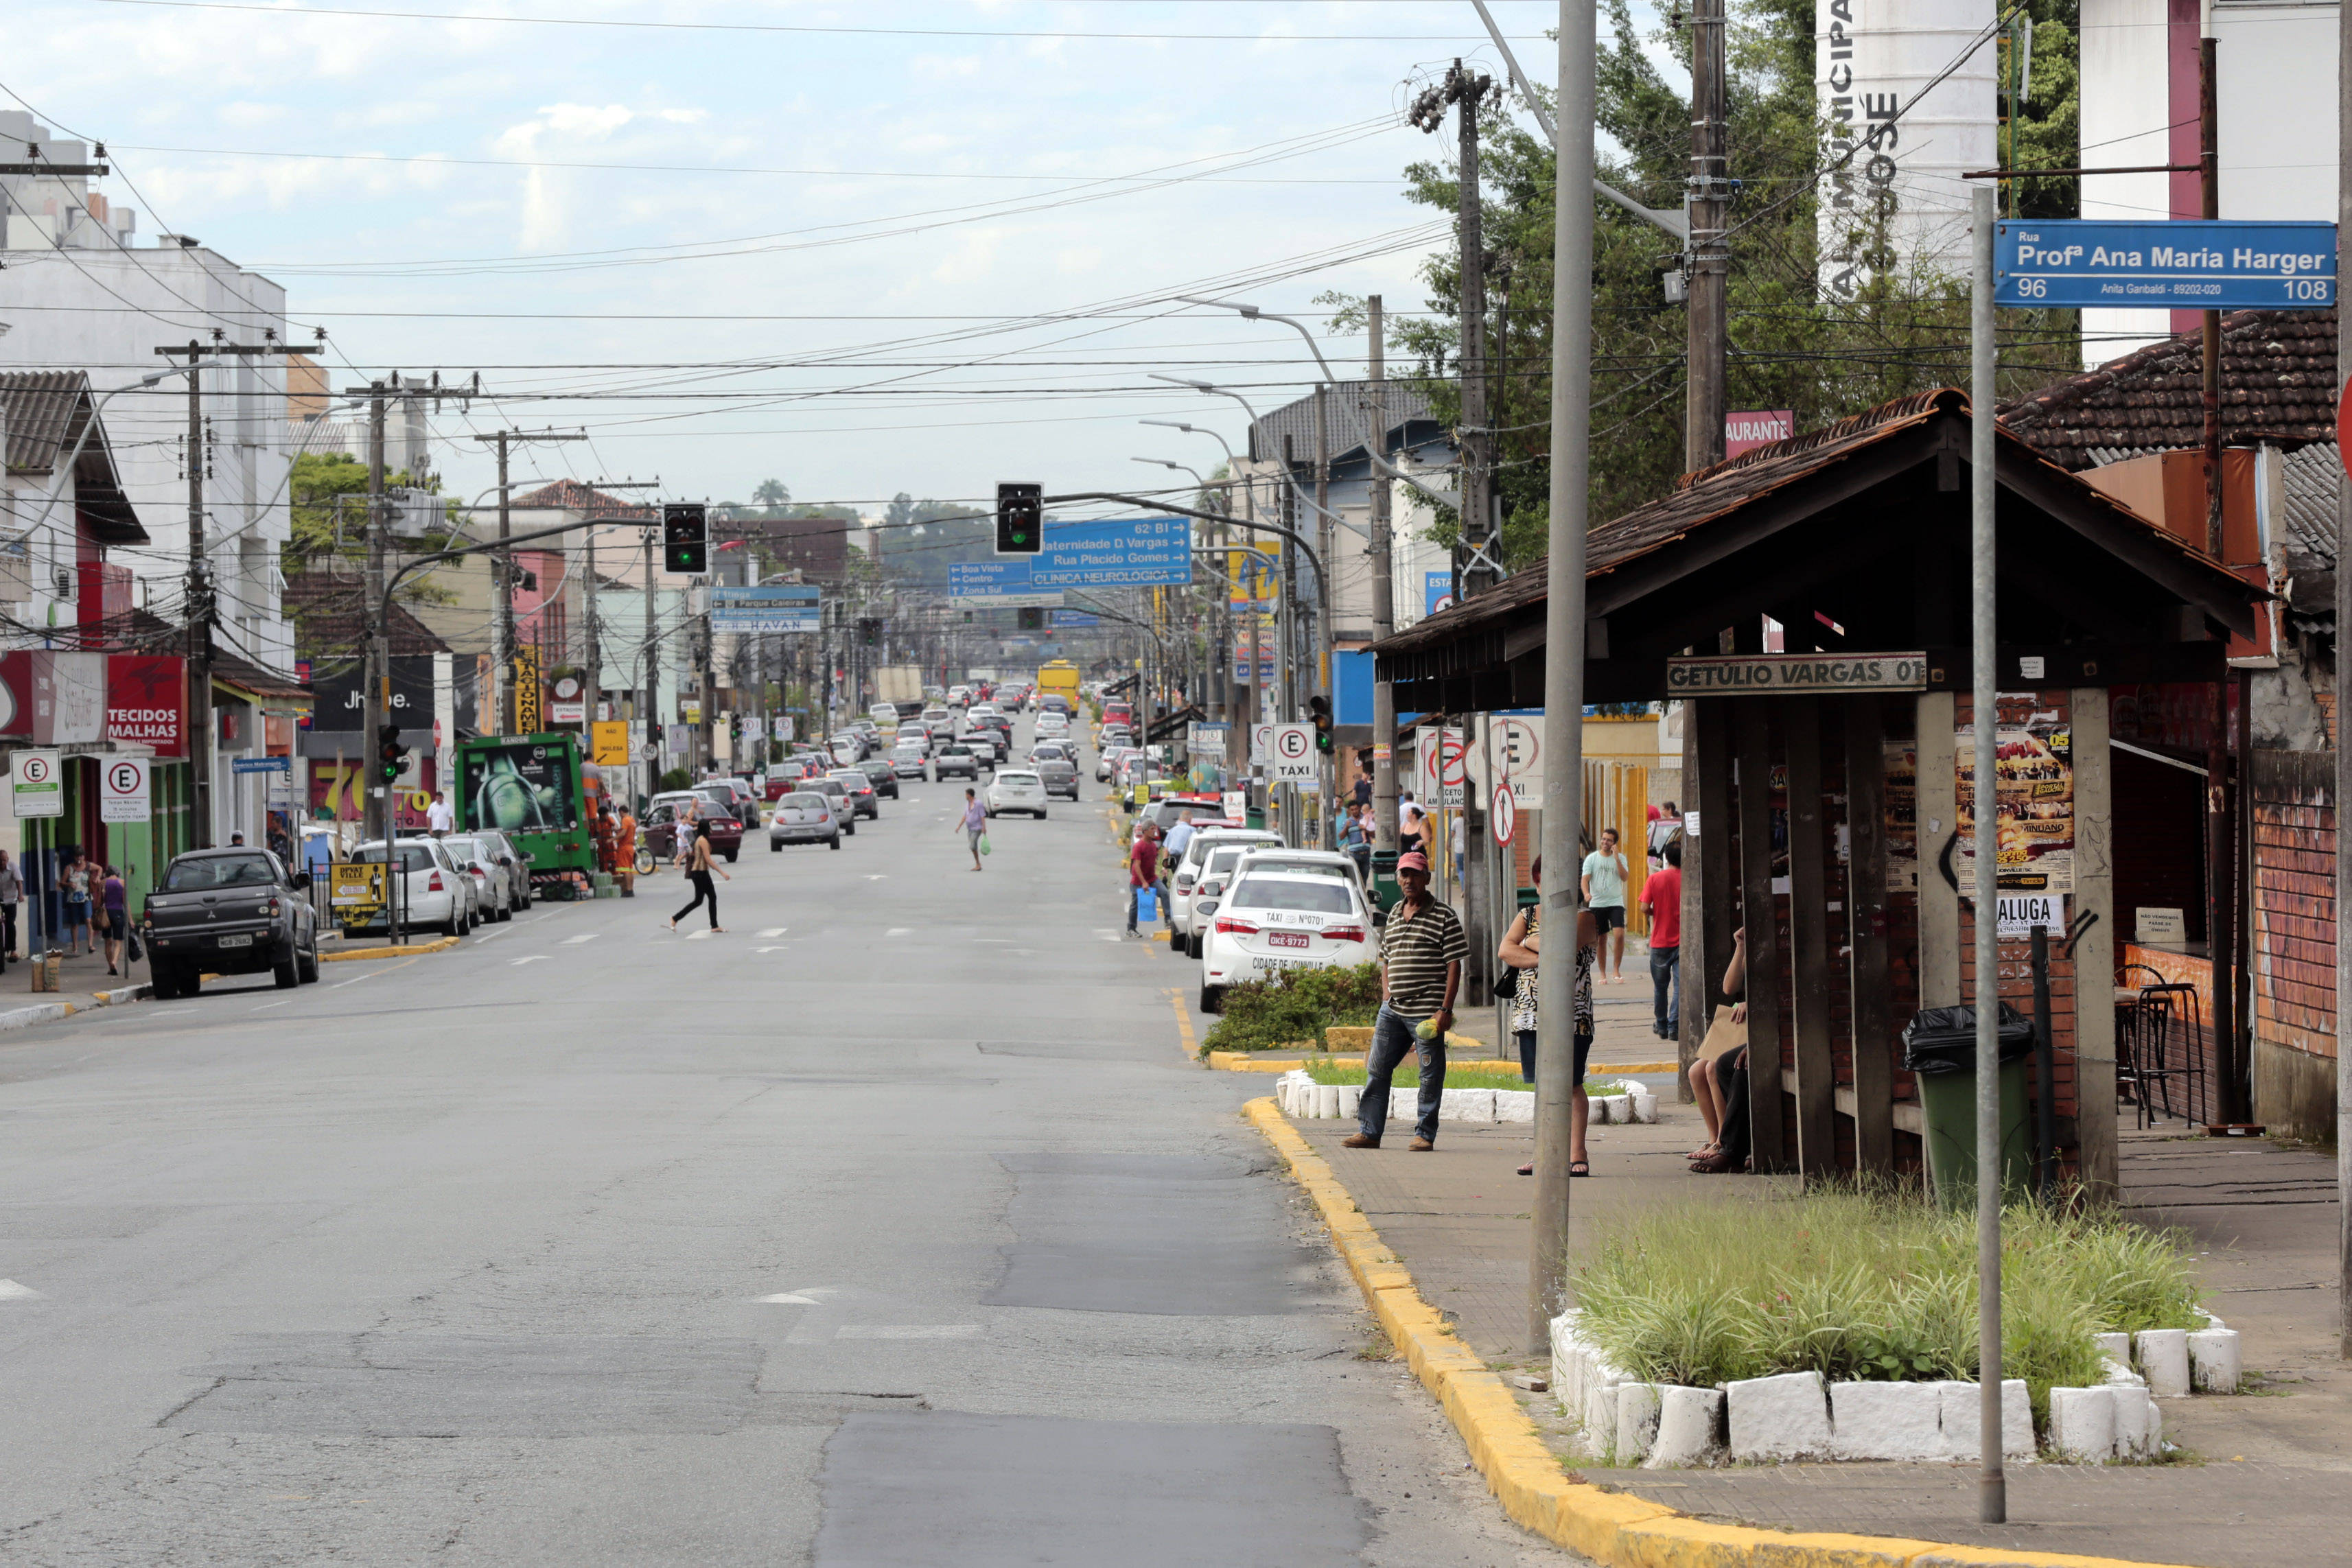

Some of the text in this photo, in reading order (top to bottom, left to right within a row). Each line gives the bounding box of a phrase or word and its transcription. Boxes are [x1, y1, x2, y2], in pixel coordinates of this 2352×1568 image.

[2018, 231, 2040, 242] Rua
[2089, 246, 2143, 267] Ana
[2151, 246, 2224, 269] Maria
[2233, 248, 2326, 274] Harger
[2017, 277, 2047, 299] 96
[2101, 283, 2124, 294] Anita
[2173, 284, 2222, 295] 89202-020
[2283, 280, 2328, 301] 108
[1043, 539, 1110, 552] aternidade
[1127, 537, 1169, 550] Vargas
[1053, 554, 1078, 565] Rua
[1128, 552, 1169, 563] Gomes
[961, 565, 1004, 574] Boa Vista
[962, 574, 993, 583] Centro
[962, 585, 1002, 595] Zona Sul
[739, 600, 769, 608] Parque
[751, 620, 801, 630] HAVAN
[1668, 662, 1772, 686] GETÚLIO
[1781, 661, 1883, 684] VARGAS
[108, 709, 177, 722] TECIDOS
[108, 724, 177, 738] MALHAS
[1288, 735, 1299, 753] E
[2049, 734, 2069, 747] 05
[645, 746, 655, 754] 60
[32, 763, 40, 777] E
[1279, 764, 1309, 775] TÁXI
[118, 769, 130, 788] E
[1998, 898, 2051, 920] ALUGA
[1266, 912, 1283, 923] TÁXI
[1253, 957, 1277, 970] CIDADE
[1278, 959, 1288, 971] DE
